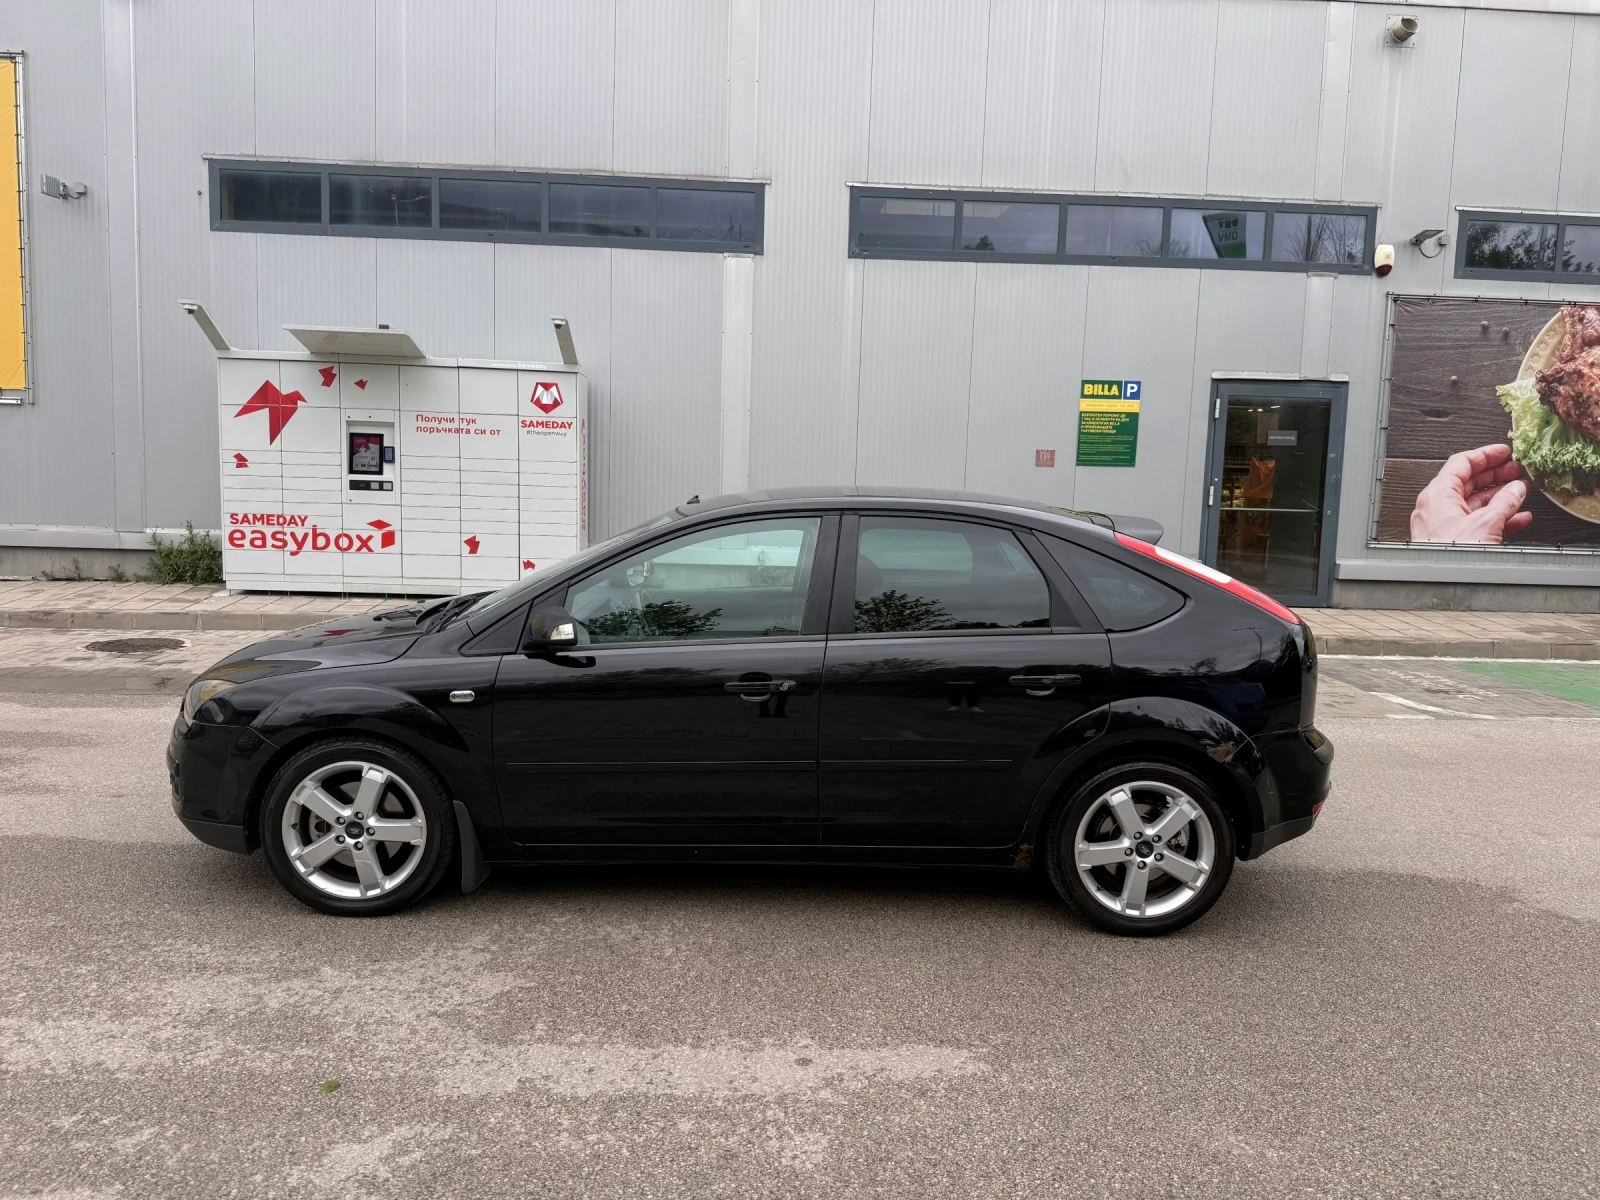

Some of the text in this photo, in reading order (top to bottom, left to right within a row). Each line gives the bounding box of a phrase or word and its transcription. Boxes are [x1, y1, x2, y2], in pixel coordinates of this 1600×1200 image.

[1083, 383, 1138, 398] BILLA P
[416, 414, 477, 426] Получи тук
[520, 419, 573, 430] SAMEDAY
[416, 426, 471, 435] поръчката
[474, 428, 486, 436] си
[229, 513, 309, 528] SAMEDAY
[228, 525, 375, 557] easybox
